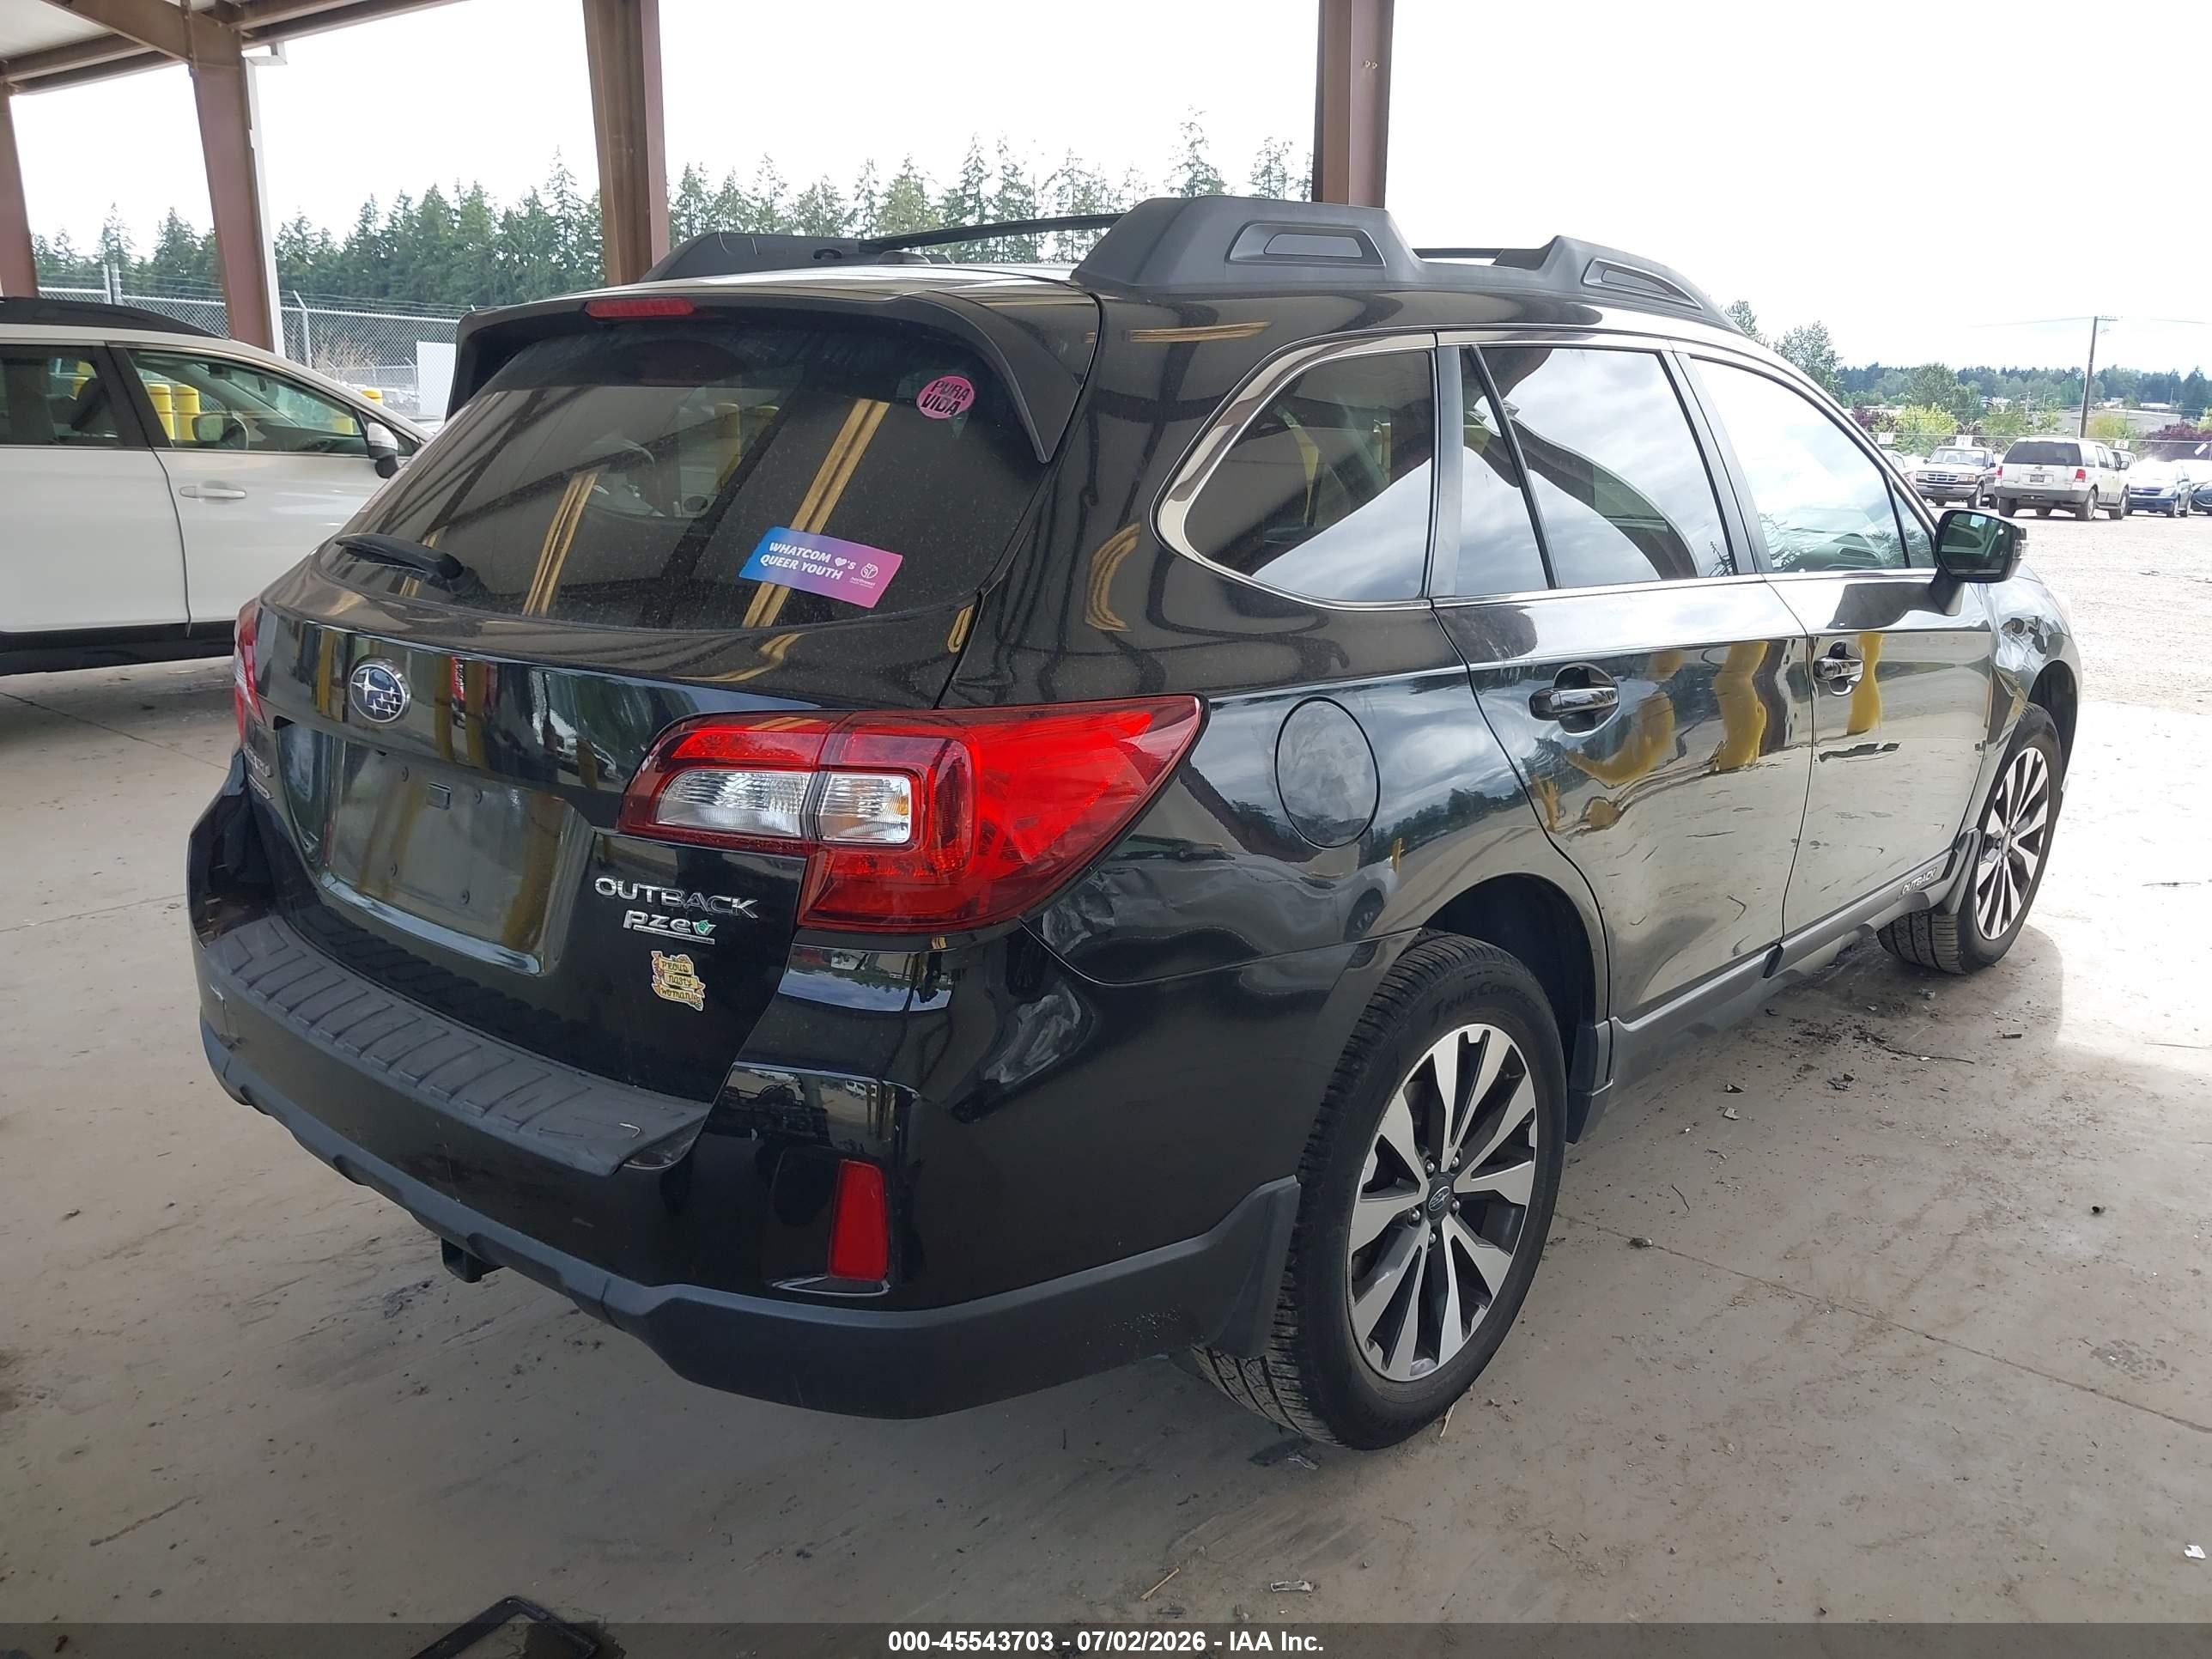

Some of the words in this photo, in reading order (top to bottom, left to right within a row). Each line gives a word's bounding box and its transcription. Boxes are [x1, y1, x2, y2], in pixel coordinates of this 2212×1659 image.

[930, 380, 970, 401] PURA
[921, 393, 961, 416] VIDA
[769, 542, 831, 563] WHATCOM
[760, 554, 799, 570] QUEER
[801, 562, 843, 580] YOUTH
[1901, 867, 1937, 895] OUTBACK
[594, 877, 759, 919] OUTBACK
